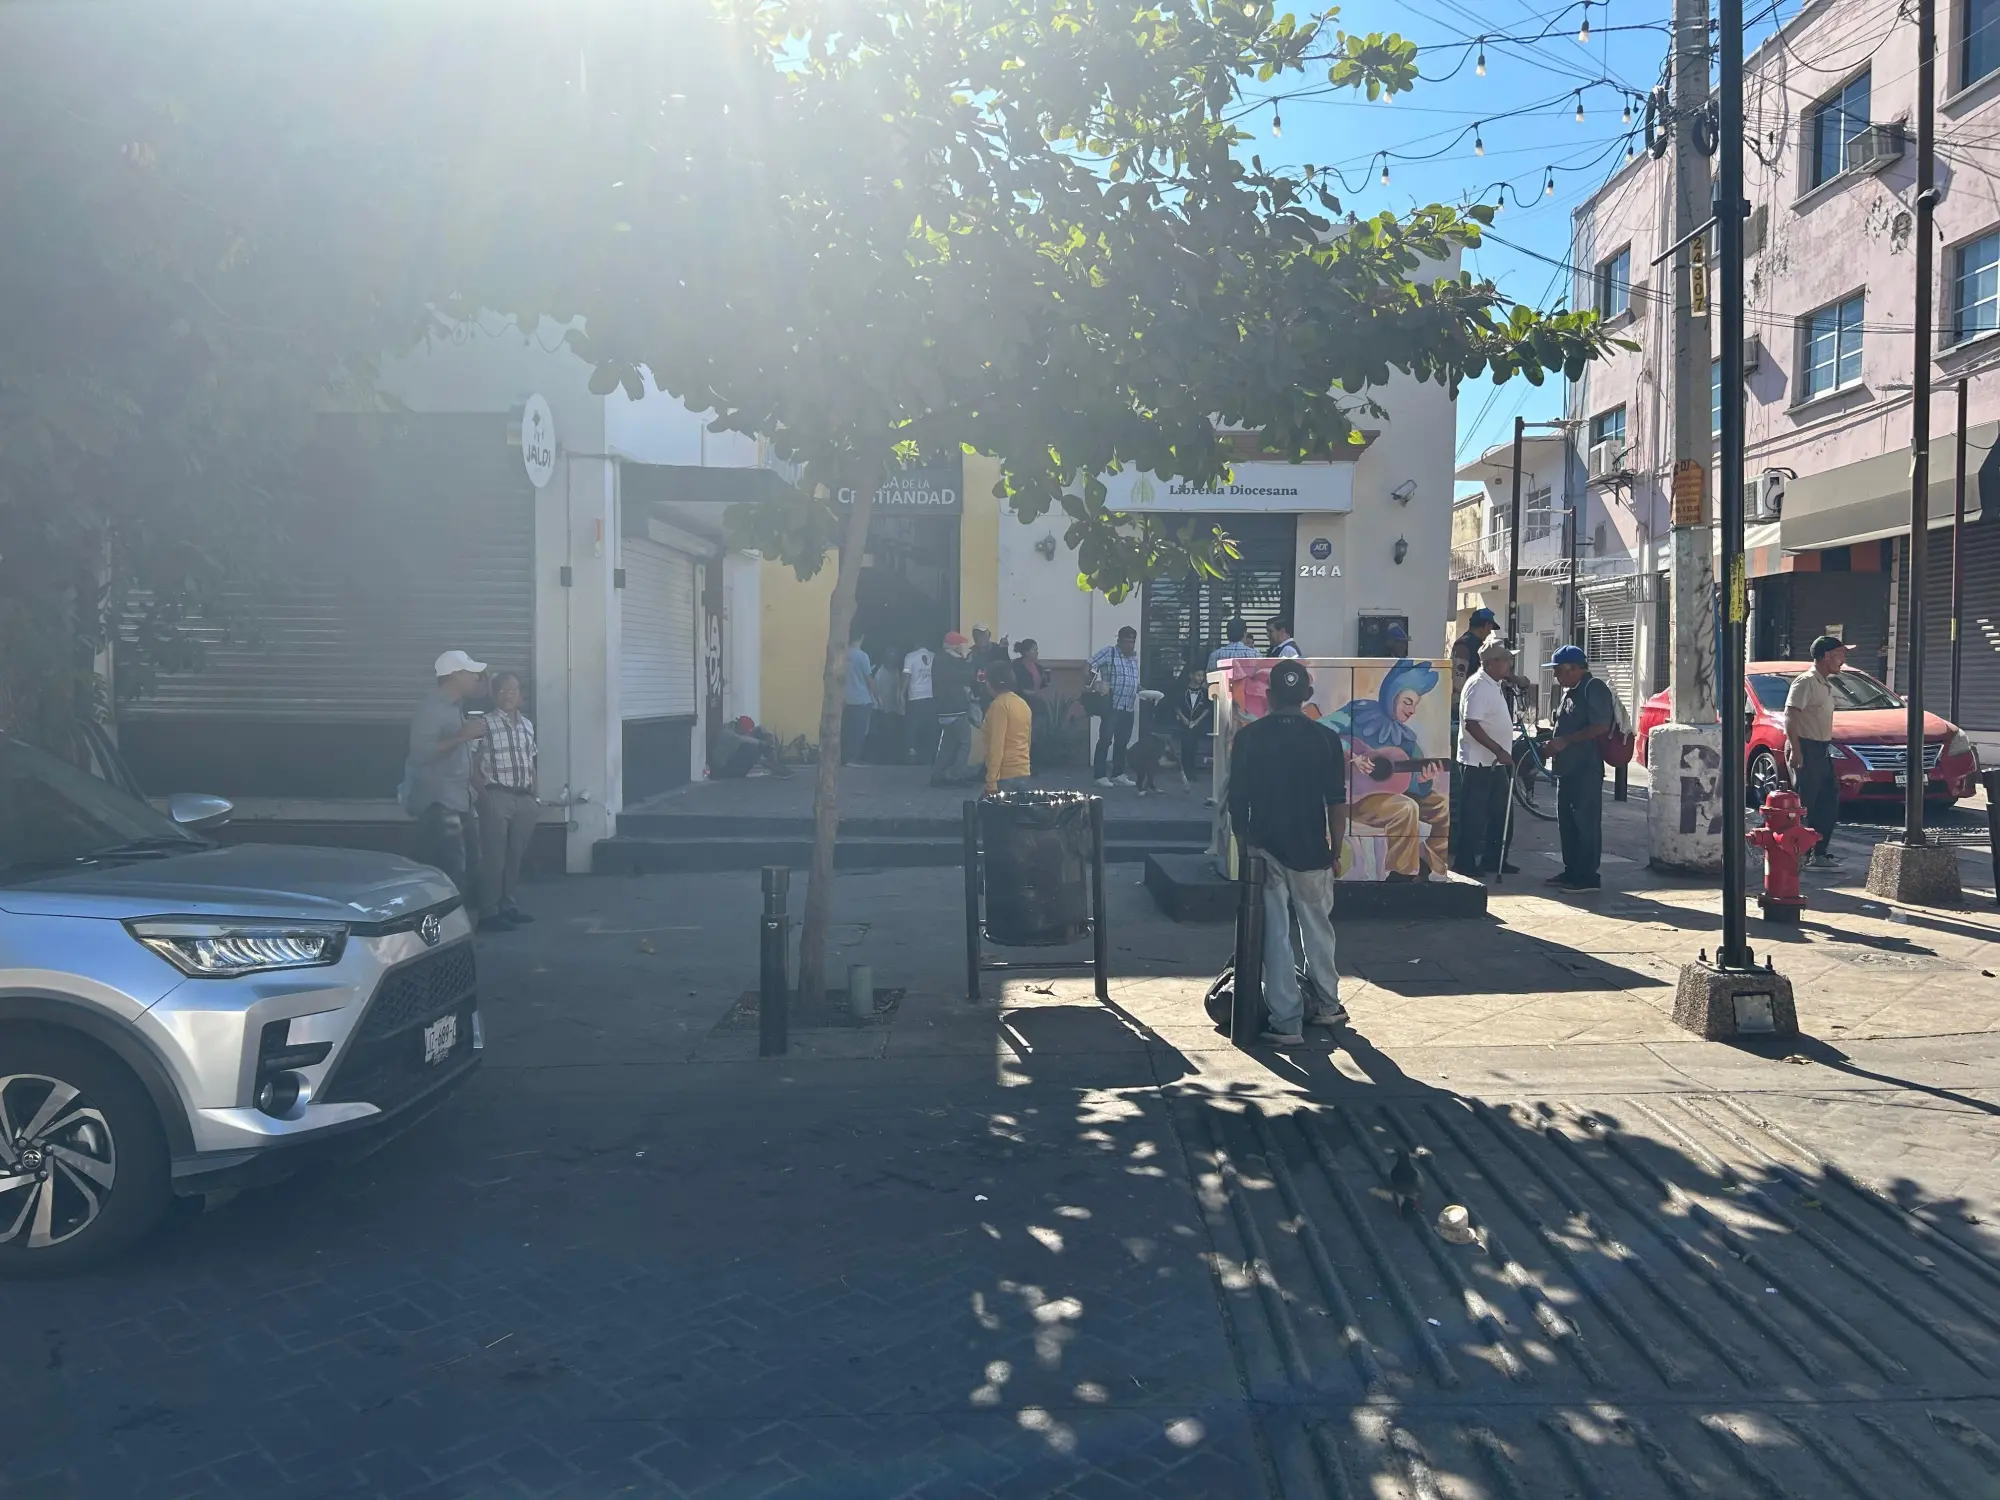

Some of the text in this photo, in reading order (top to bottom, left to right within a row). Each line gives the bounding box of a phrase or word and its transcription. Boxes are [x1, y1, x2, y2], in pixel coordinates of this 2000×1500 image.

[526, 443, 551, 469] JALDI
[902, 479, 915, 489] DE
[918, 479, 930, 489] LA
[1229, 484, 1299, 496] Diocesana
[838, 487, 956, 504] CTIANDAD
[1314, 543, 1328, 551] ADT
[1300, 565, 1341, 577] 214 A
